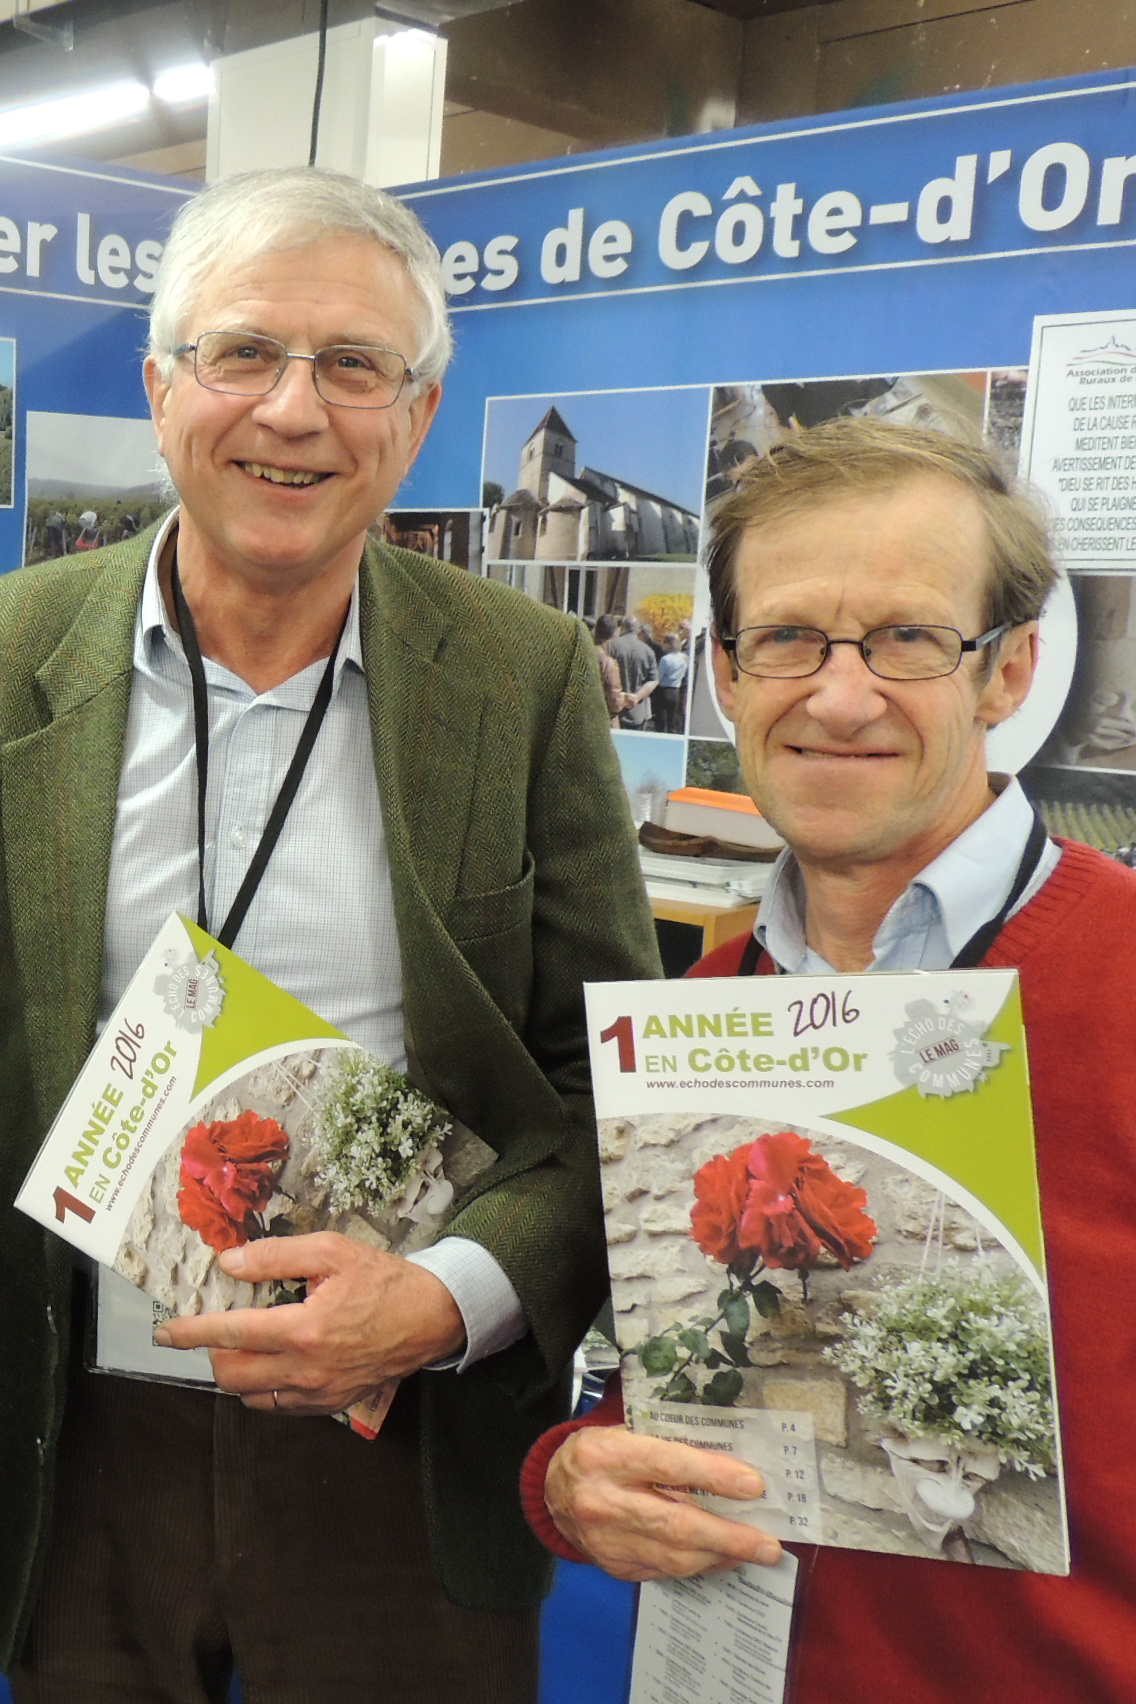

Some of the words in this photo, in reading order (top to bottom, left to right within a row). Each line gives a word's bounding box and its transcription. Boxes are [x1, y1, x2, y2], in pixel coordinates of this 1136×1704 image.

[76, 212, 164, 293] les
[540, 209, 633, 284] de
[1067, 367, 1127, 377] Association
[1079, 376, 1116, 385] Ruraux
[1068, 397, 1088, 411] QUE
[1089, 396, 1105, 410] LES
[1107, 394, 1136, 410] INTER
[1073, 417, 1087, 431] DE
[1087, 416, 1099, 430] LA
[1100, 415, 1131, 430] CAUSE
[1075, 436, 1119, 451] MEDITENT
[1052, 456, 1124, 471] AVERTISSEMENT
[1083, 477, 1094, 491] SE
[1095, 477, 1111, 490] RIT
[1111, 476, 1130, 490] DES
[1071, 497, 1086, 511] QUI
[1087, 497, 1099, 511] SE
[1071, 537, 1124, 551] CHERISSENT
[187, 978, 199, 1000] MAG
[186, 999, 196, 1009] LE
[787, 990, 860, 1037] 2016
[642, 1007, 774, 1039] ANNÉE
[937, 1016, 966, 1035] DES
[110, 1018, 145, 1080] 2016
[599, 1015, 637, 1074] 1
[919, 1048, 936, 1063] LE
[933, 1038, 960, 1056] MAG
[644, 1055, 677, 1073] EN
[688, 1046, 868, 1073] Côte-d'Or
[908, 1037, 982, 1088] COMMUNES
[646, 1078, 834, 1089] www.echodescommunes.com
[88, 1173, 111, 1204] EN
[102, 1040, 177, 1170] Côte-d'Or
[64, 1083, 124, 1189] ANNÉE
[105, 1075, 177, 1212] www.echodescommunes.com
[52, 1185, 97, 1224] 1
[685, 1414, 700, 1426] DES
[701, 1416, 745, 1430] COMMUNES
[789, 1423, 796, 1432] 4
